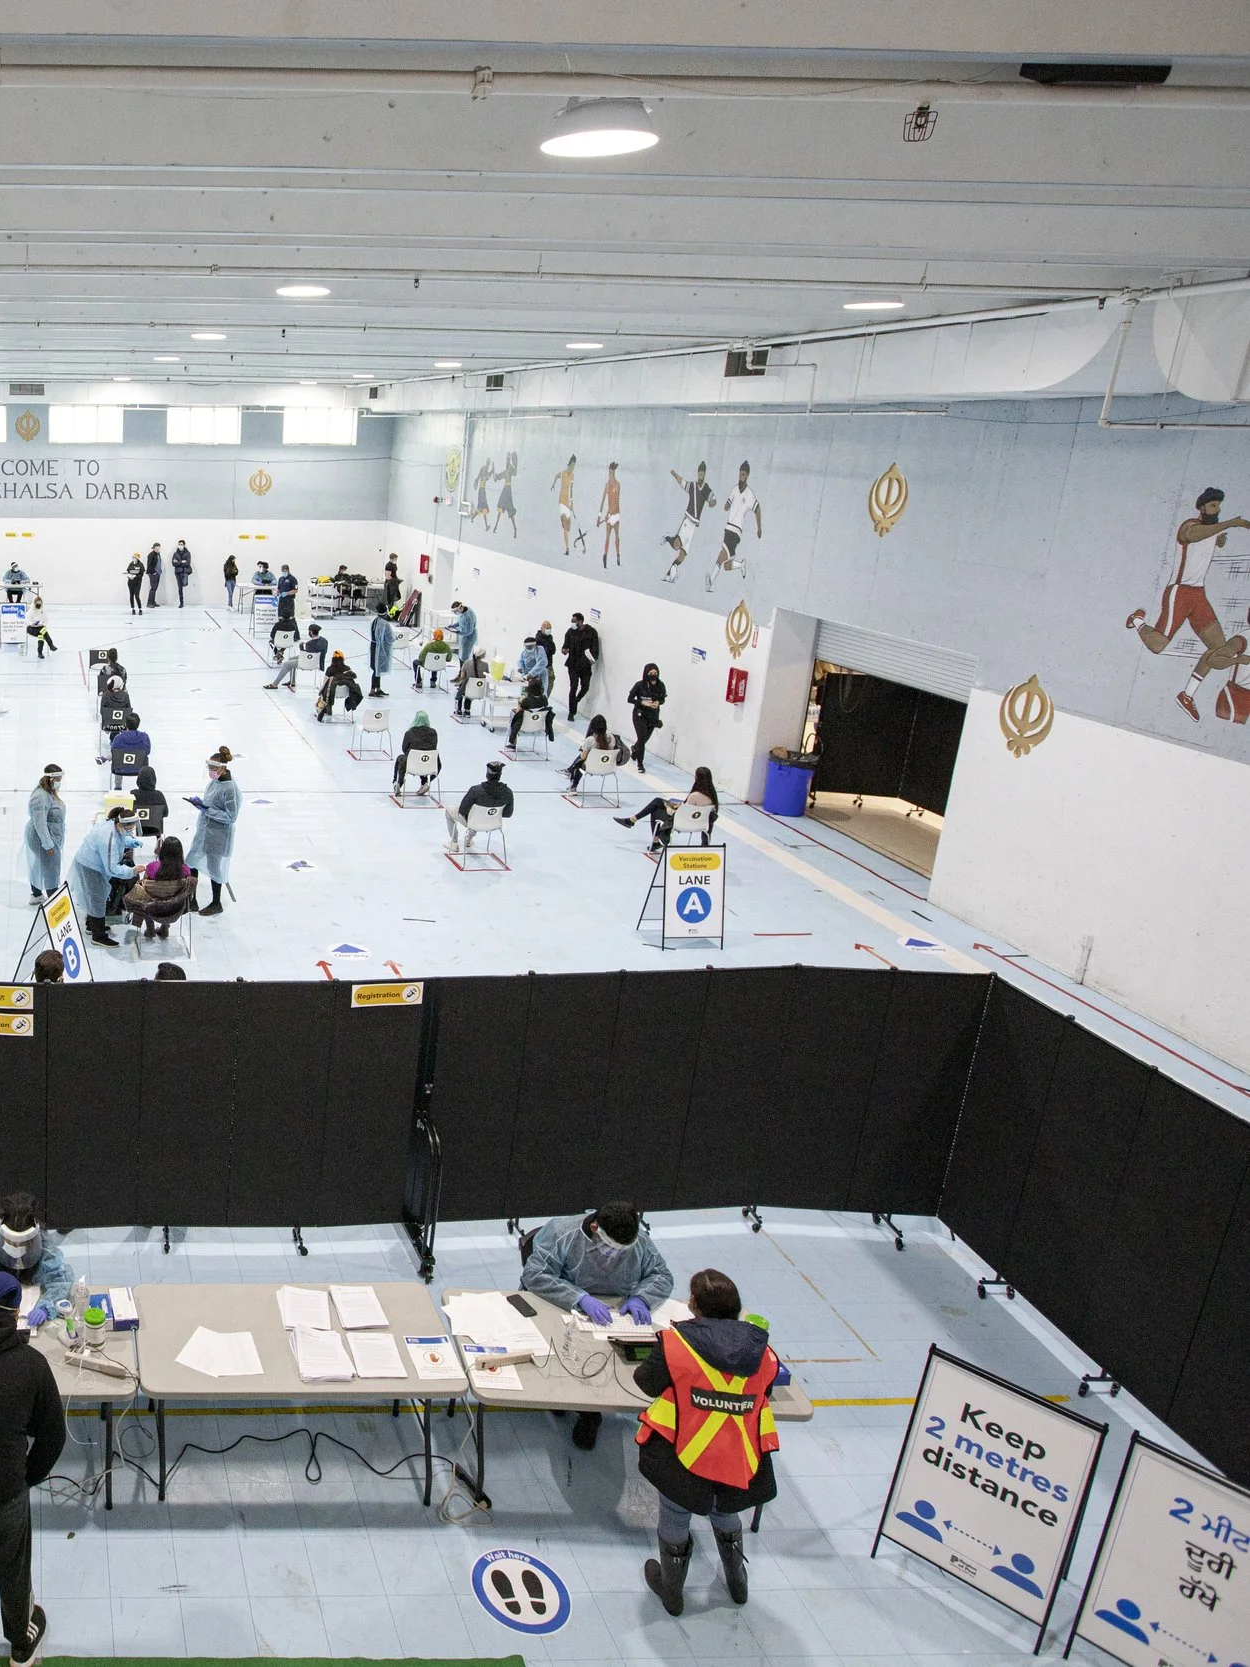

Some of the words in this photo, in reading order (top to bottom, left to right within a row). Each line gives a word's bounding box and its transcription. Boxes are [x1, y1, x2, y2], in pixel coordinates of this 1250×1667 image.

[73, 459, 100, 476] TO
[85, 482, 169, 500] DARBAR
[679, 876, 710, 885] LANE
[683, 892, 704, 914] A
[56, 921, 72, 942] LANE
[66, 944, 77, 972] B
[357, 992, 400, 1000] Registration
[960, 1402, 1046, 1460] Keep
[925, 1416, 946, 1440] 2
[954, 1434, 1069, 1502] metres
[922, 1446, 1058, 1527] distance
[1168, 1497, 1194, 1525] 2
[1200, 1514, 1250, 1553] ਮੀਟ
[484, 1551, 506, 1562] Wait
[508, 1551, 530, 1563] here
[1185, 1540, 1237, 1580] ਦੂਰੀ
